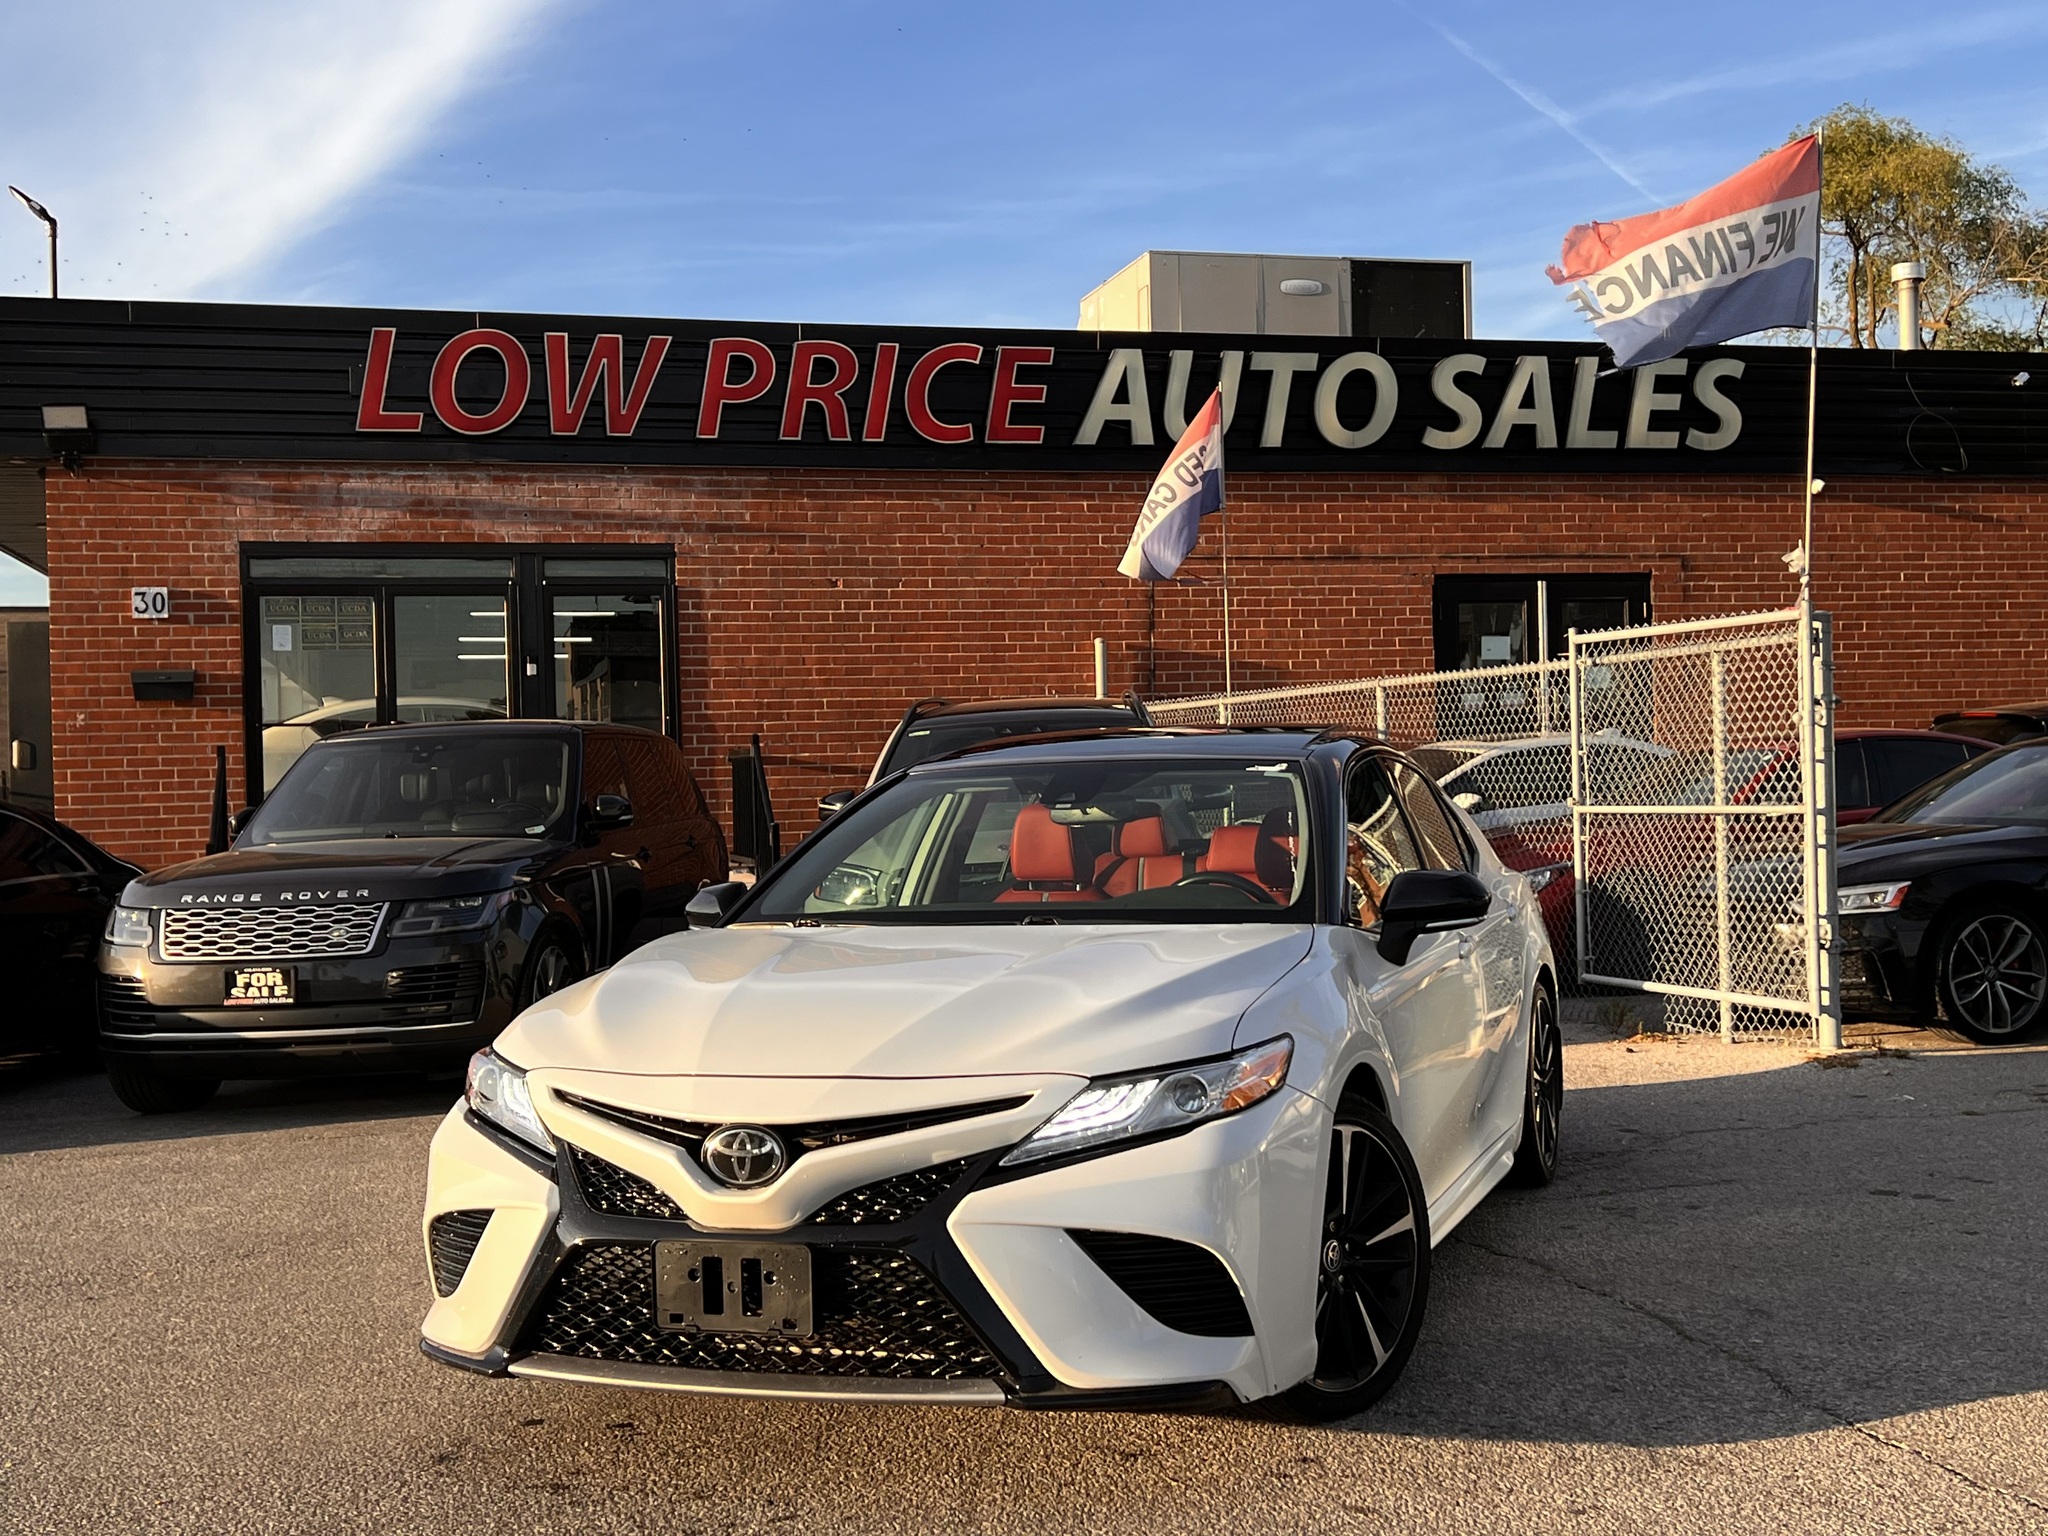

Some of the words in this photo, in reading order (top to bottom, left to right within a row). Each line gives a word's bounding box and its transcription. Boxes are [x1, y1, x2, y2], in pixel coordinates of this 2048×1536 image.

[355, 327, 673, 436] LOW
[696, 337, 1055, 444] PRICE
[1072, 348, 1398, 449] AUTO
[1421, 353, 1746, 450] SALES
[134, 592, 166, 614] 30
[270, 604, 296, 612] UCDA
[306, 604, 332, 612] UCDA
[342, 604, 367, 612] UCDA
[307, 632, 332, 640] UCDA
[343, 630, 368, 639] UCDA
[180, 893, 262, 904] RANGE
[280, 889, 369, 901] ROVER
[236, 972, 283, 988] FOR
[230, 985, 288, 998] SALE
